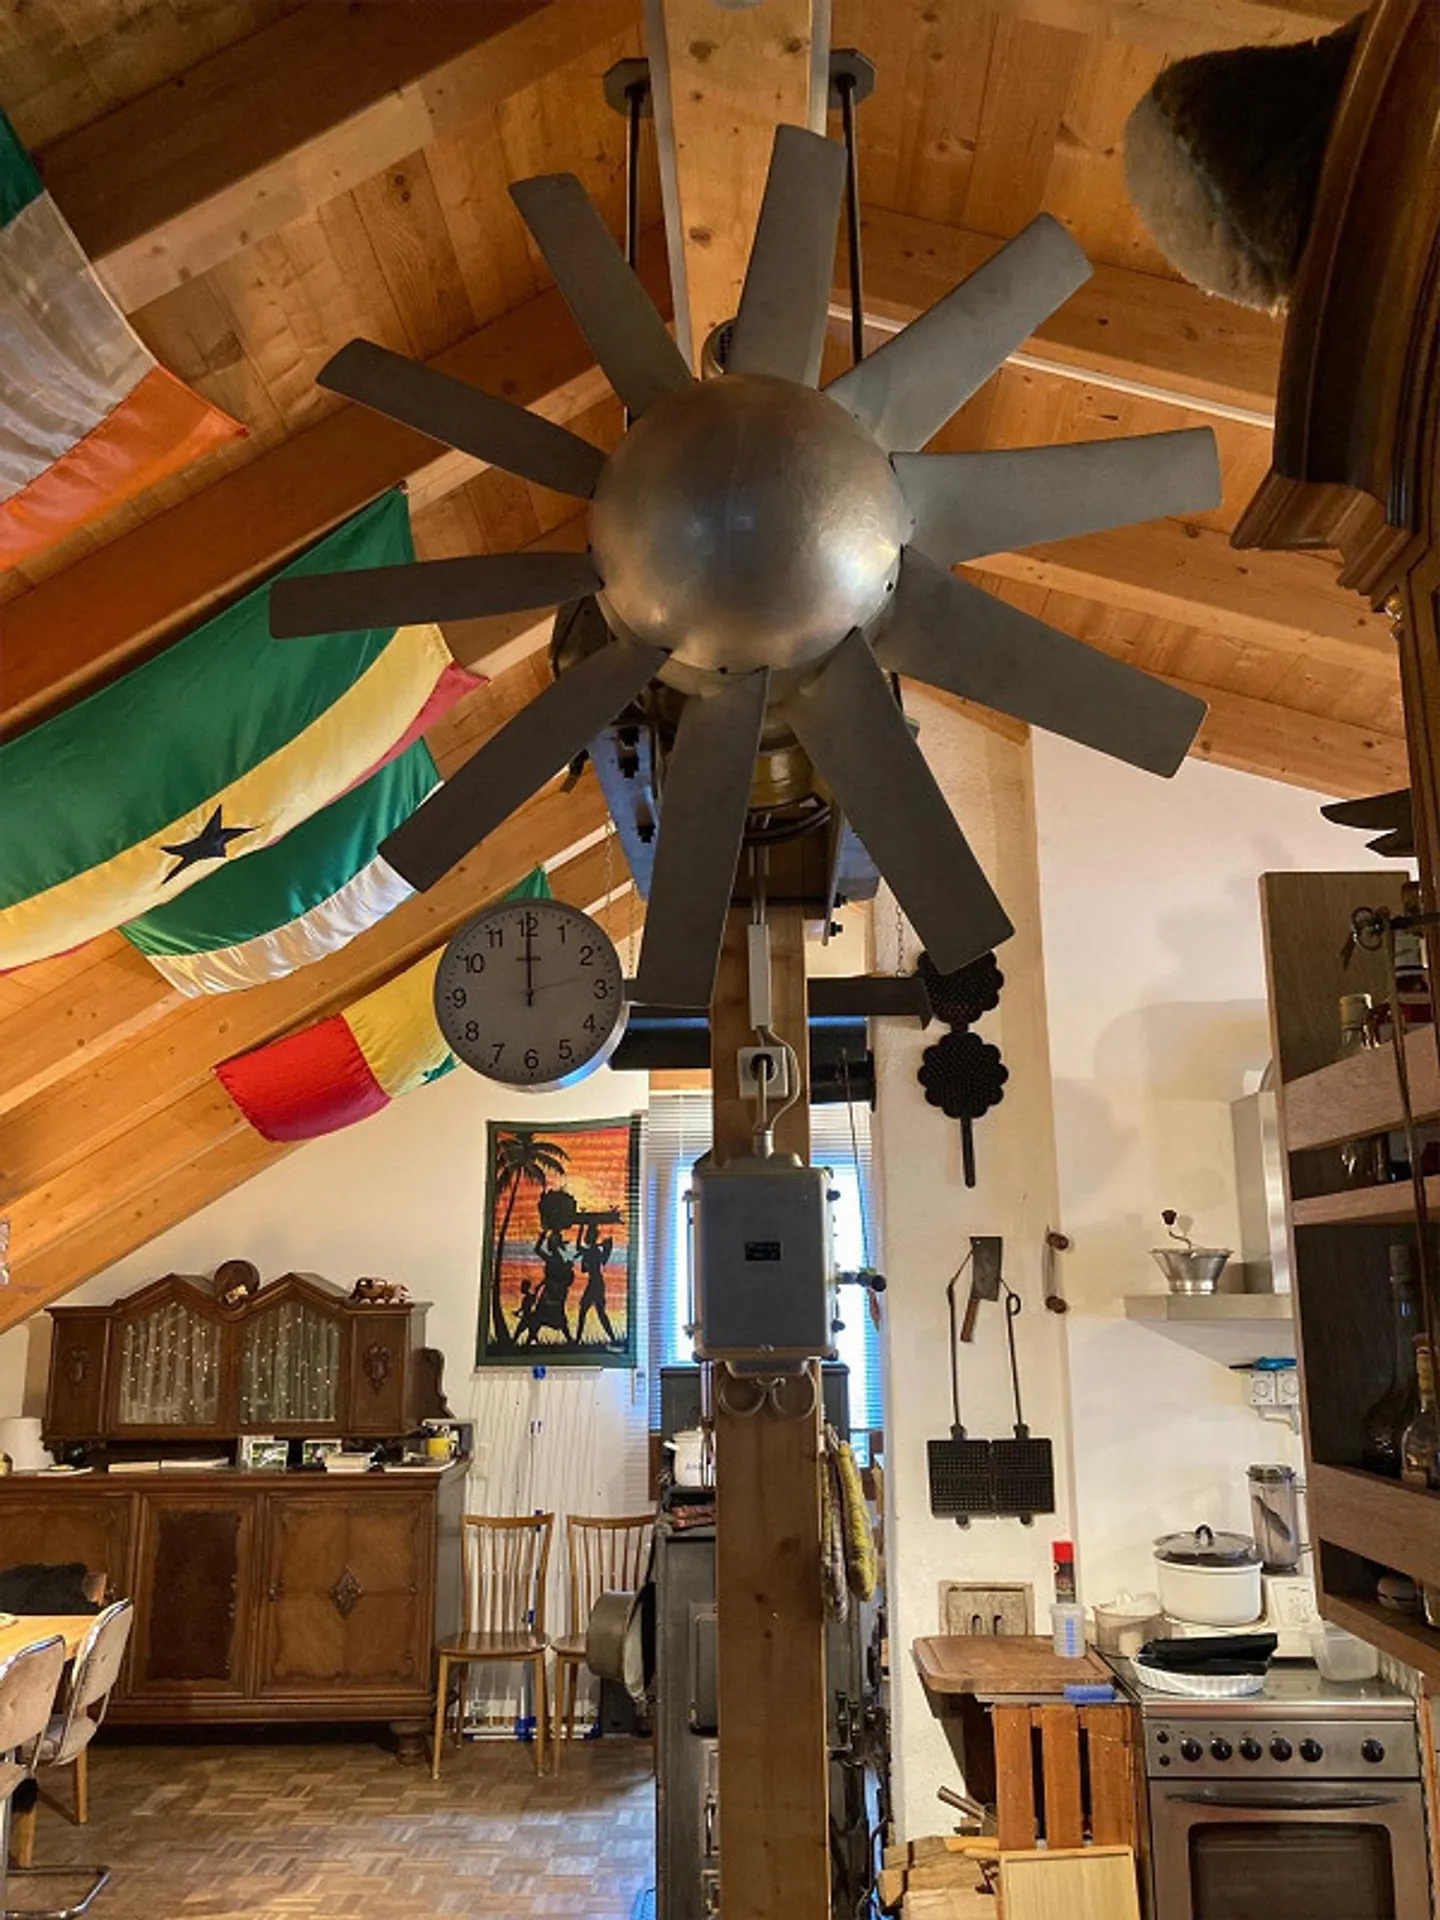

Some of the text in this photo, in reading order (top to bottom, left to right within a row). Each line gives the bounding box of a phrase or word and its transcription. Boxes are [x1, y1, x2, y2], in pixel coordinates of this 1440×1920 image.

[516, 916, 539, 938] 12
[557, 925, 567, 945] 1
[486, 929, 504, 948] 11
[463, 953, 485, 973] 10
[579, 945, 595, 966] 2
[451, 988, 467, 1009] 9
[592, 979, 609, 1000] 3
[465, 1020, 480, 1042] 8
[582, 1013, 596, 1034] 4
[492, 1044, 506, 1064] 7
[524, 1049, 540, 1069] 6
[558, 1039, 573, 1060] 5
